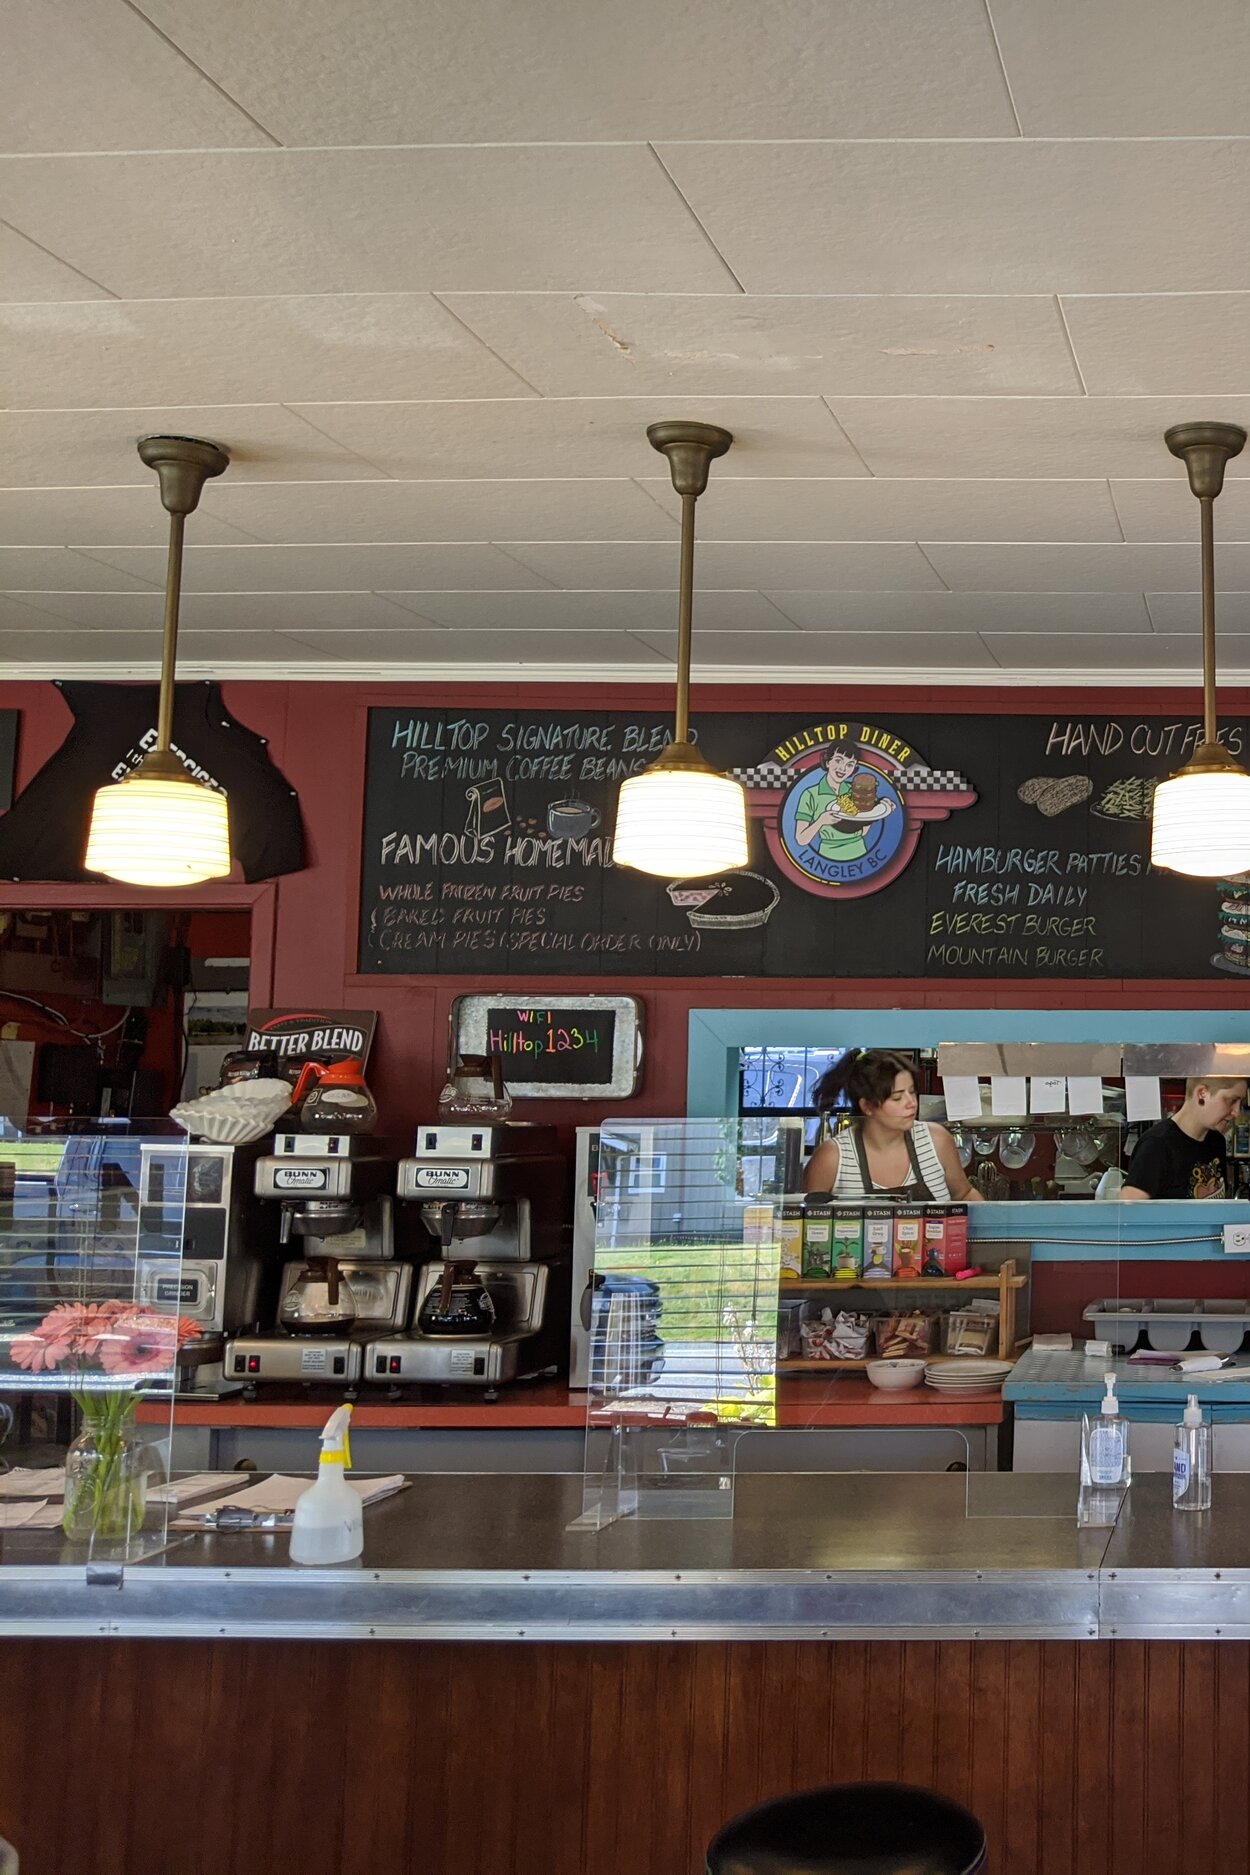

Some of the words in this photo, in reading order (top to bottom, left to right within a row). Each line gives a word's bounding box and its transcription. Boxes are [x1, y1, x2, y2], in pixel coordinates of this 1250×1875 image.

[392, 719, 489, 749] HILLTOP
[497, 721, 615, 751] SIGNATURE
[775, 724, 848, 762] HILLTOP
[860, 726, 911, 763] DINER
[1046, 722, 1124, 756] HAND
[1131, 722, 1182, 756] CUT
[1180, 723, 1242, 756] FRES
[402, 751, 498, 780] PREMIUM
[506, 755, 575, 781] COFFEE
[381, 831, 495, 866] FAMOUS
[504, 836, 622, 869] HOMEMAD
[798, 850, 864, 878] LANGLEY
[868, 850, 888, 868] BC
[935, 845, 1062, 875] HAMBURGER
[1066, 851, 1142, 876] PATTIES
[379, 881, 434, 901] WHOLE
[501, 884, 545, 901] FRUIT
[548, 885, 585, 901] PIES
[952, 880, 1020, 906] FRESH
[1026, 882, 1088, 906] DAILY
[453, 908, 504, 927] FRUIT
[930, 911, 1016, 935] EVEREST
[1022, 915, 1097, 936] BURGER
[453, 930, 496, 949] PIES
[927, 946, 1028, 966] MOUNTAIN
[1035, 947, 1104, 967] BURGER
[248, 1031, 309, 1056] BETTER
[311, 1028, 363, 1052] BLEND
[426, 1170, 460, 1178] BUNN
